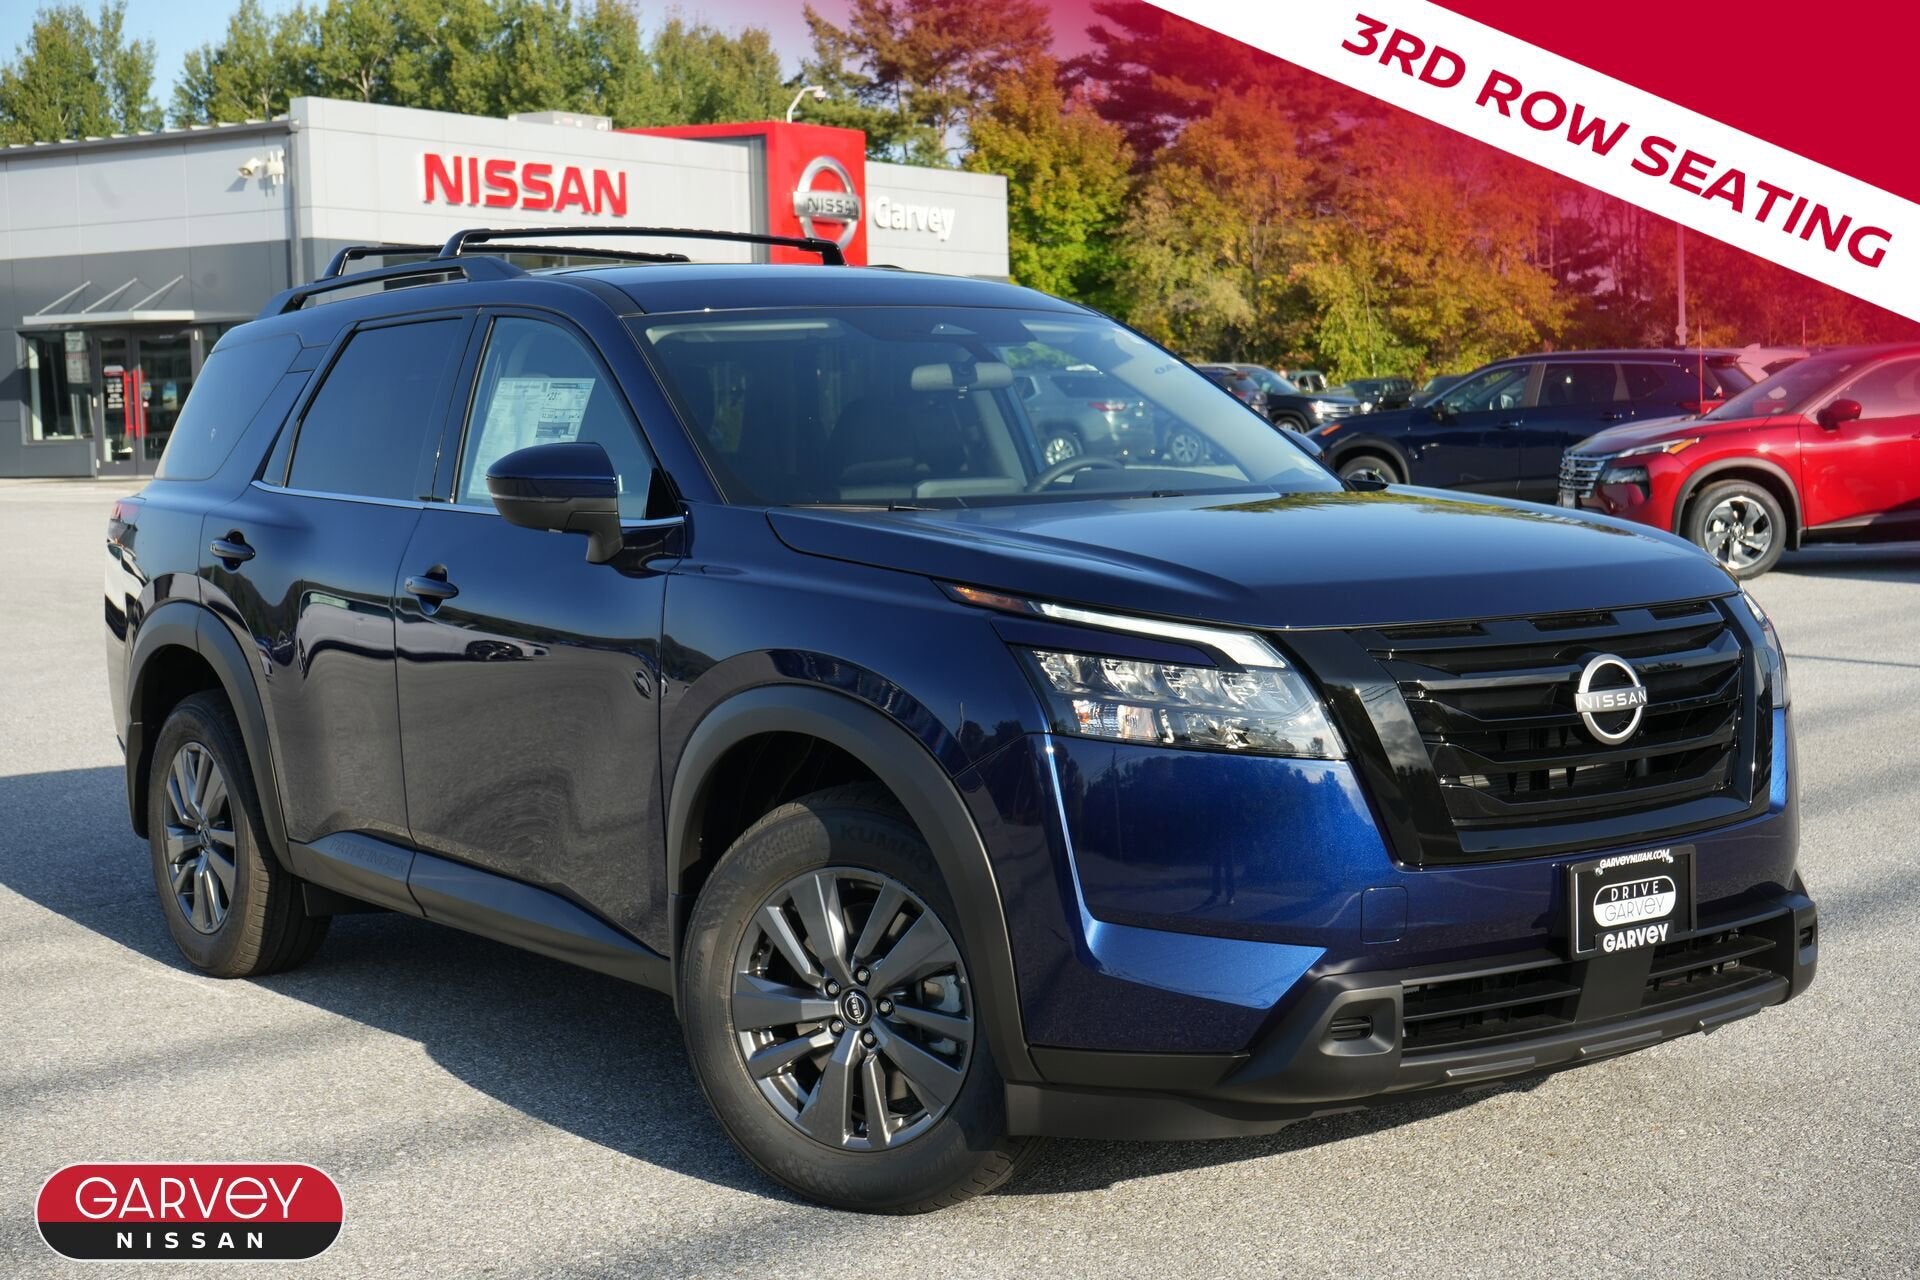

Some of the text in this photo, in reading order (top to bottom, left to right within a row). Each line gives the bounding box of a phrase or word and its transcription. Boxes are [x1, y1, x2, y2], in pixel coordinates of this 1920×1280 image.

[424, 153, 628, 216] NISSAN
[807, 196, 858, 217] NISSAN
[874, 196, 955, 242] Garvey
[1578, 689, 1648, 709] NISSAN
[1611, 880, 1659, 901] DRIVE
